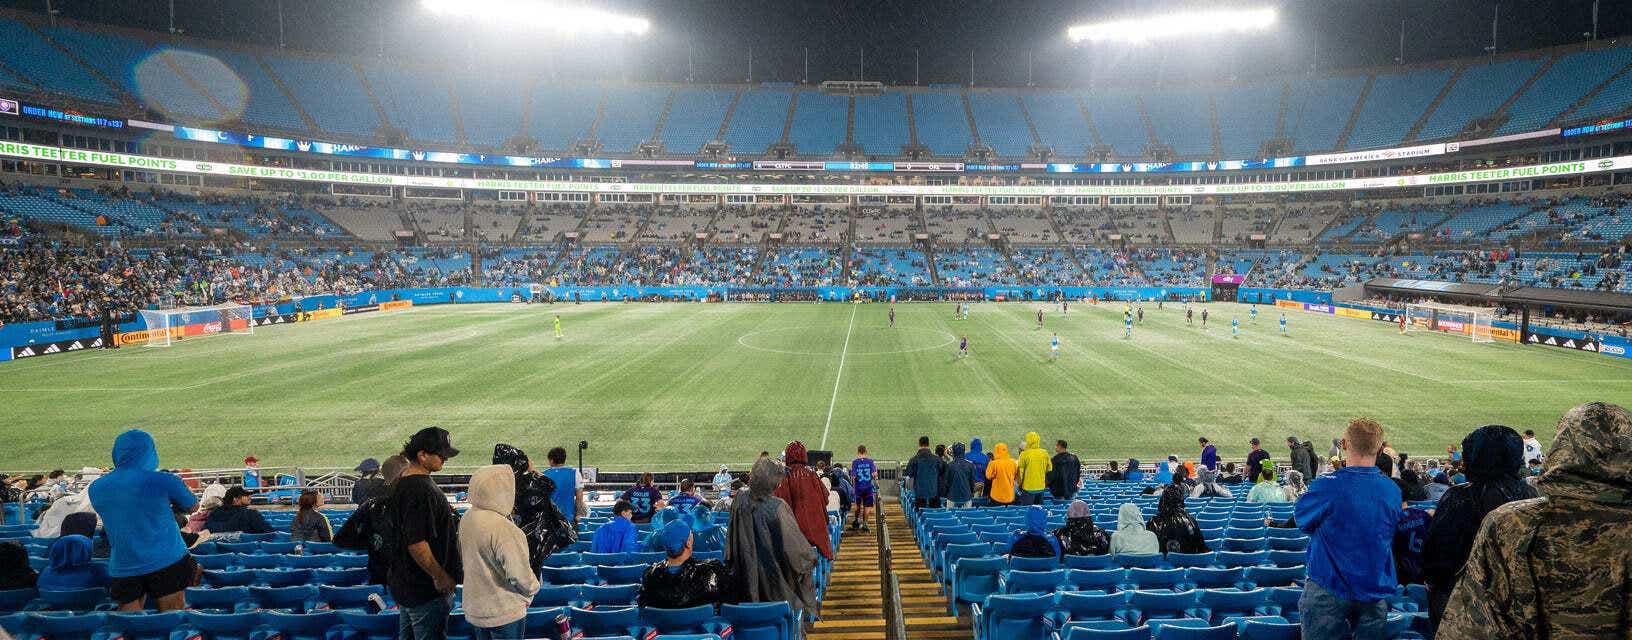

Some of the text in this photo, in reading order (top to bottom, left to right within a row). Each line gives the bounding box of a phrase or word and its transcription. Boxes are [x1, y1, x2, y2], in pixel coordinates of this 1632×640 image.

[32, 146, 87, 161] TEETER
[91, 152, 125, 165] FUEL
[129, 156, 177, 170] POINTS
[229, 165, 257, 176] SAVE
[261, 167, 277, 177] UP
[279, 169, 293, 178] TO
[328, 173, 351, 182] PER
[352, 175, 393, 184] GALLON
[1429, 173, 1468, 182] HARRIS
[1470, 169, 1510, 180] TEETER
[1512, 167, 1539, 177] FUEL
[1541, 163, 1586, 175] POINTS
